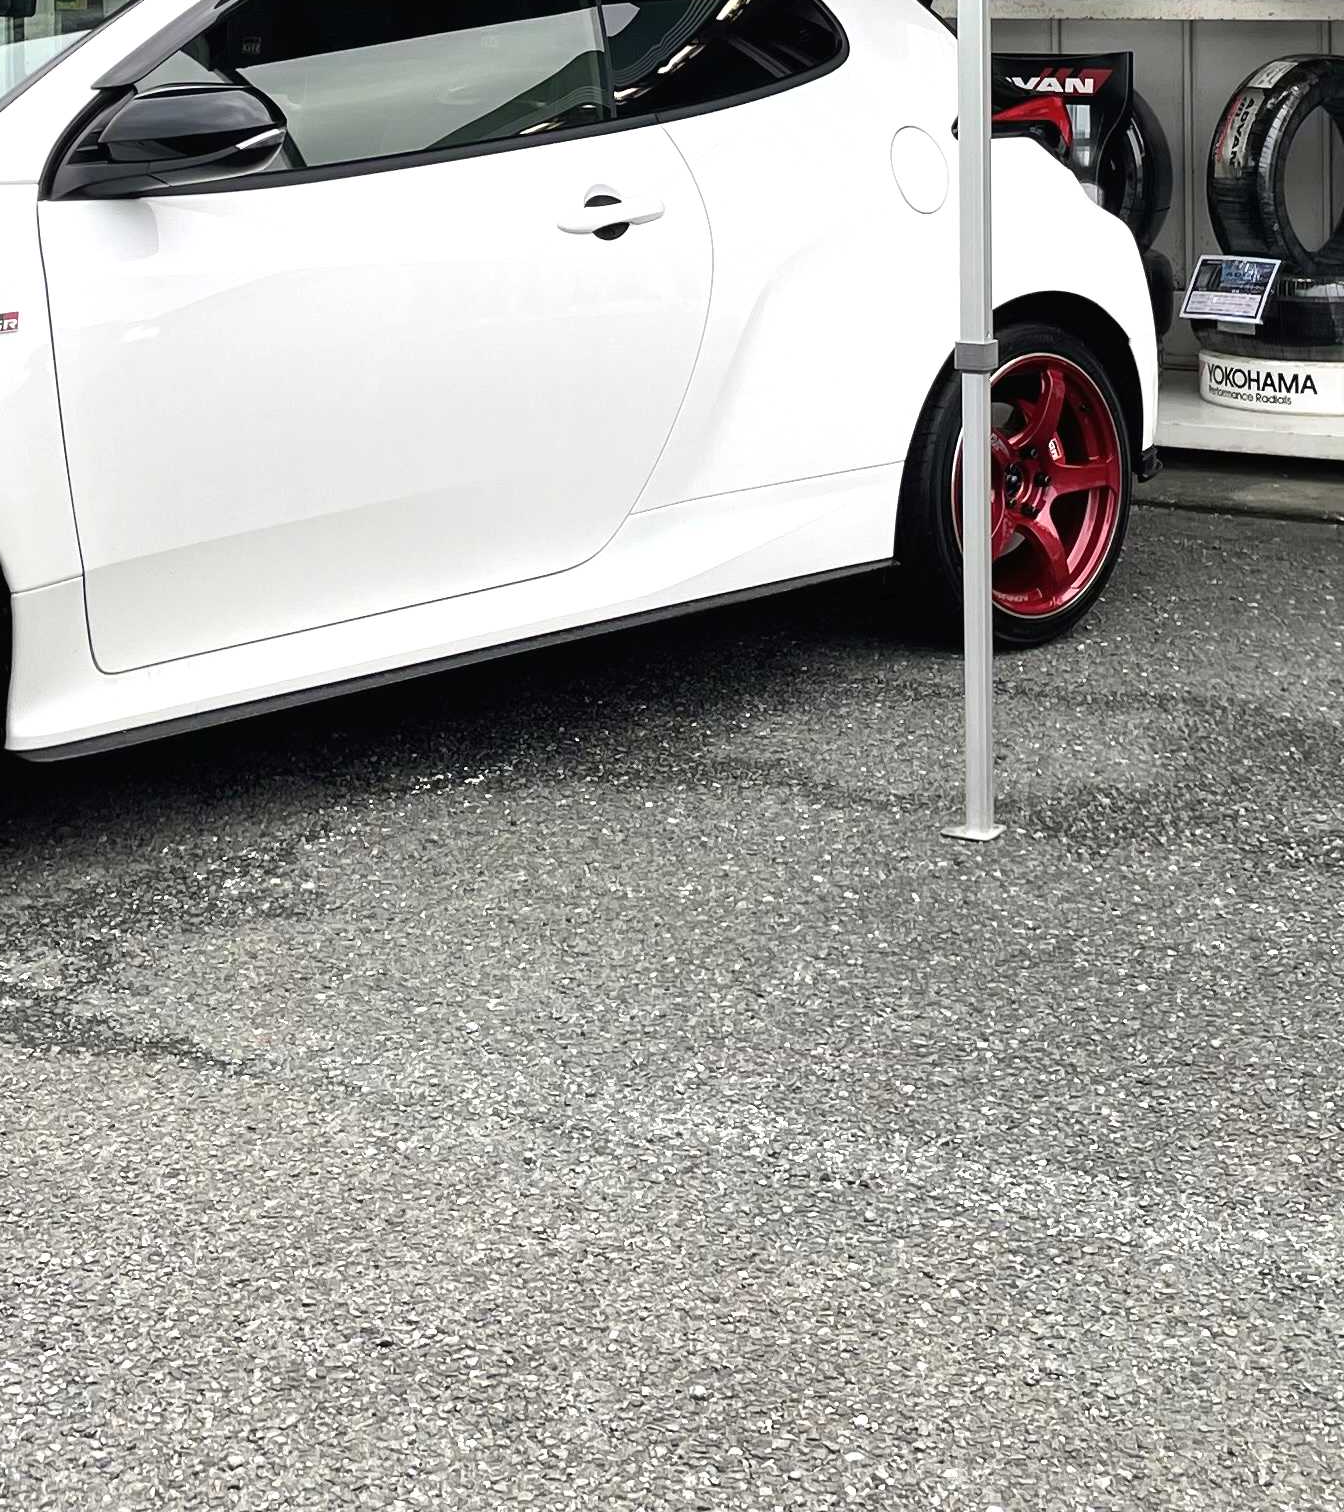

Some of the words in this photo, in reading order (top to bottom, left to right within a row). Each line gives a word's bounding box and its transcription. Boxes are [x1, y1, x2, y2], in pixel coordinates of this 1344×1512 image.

[1005, 76, 1094, 94] VAN
[1207, 362, 1318, 395] YOKOHAMA
[1255, 392, 1292, 406] Radials
